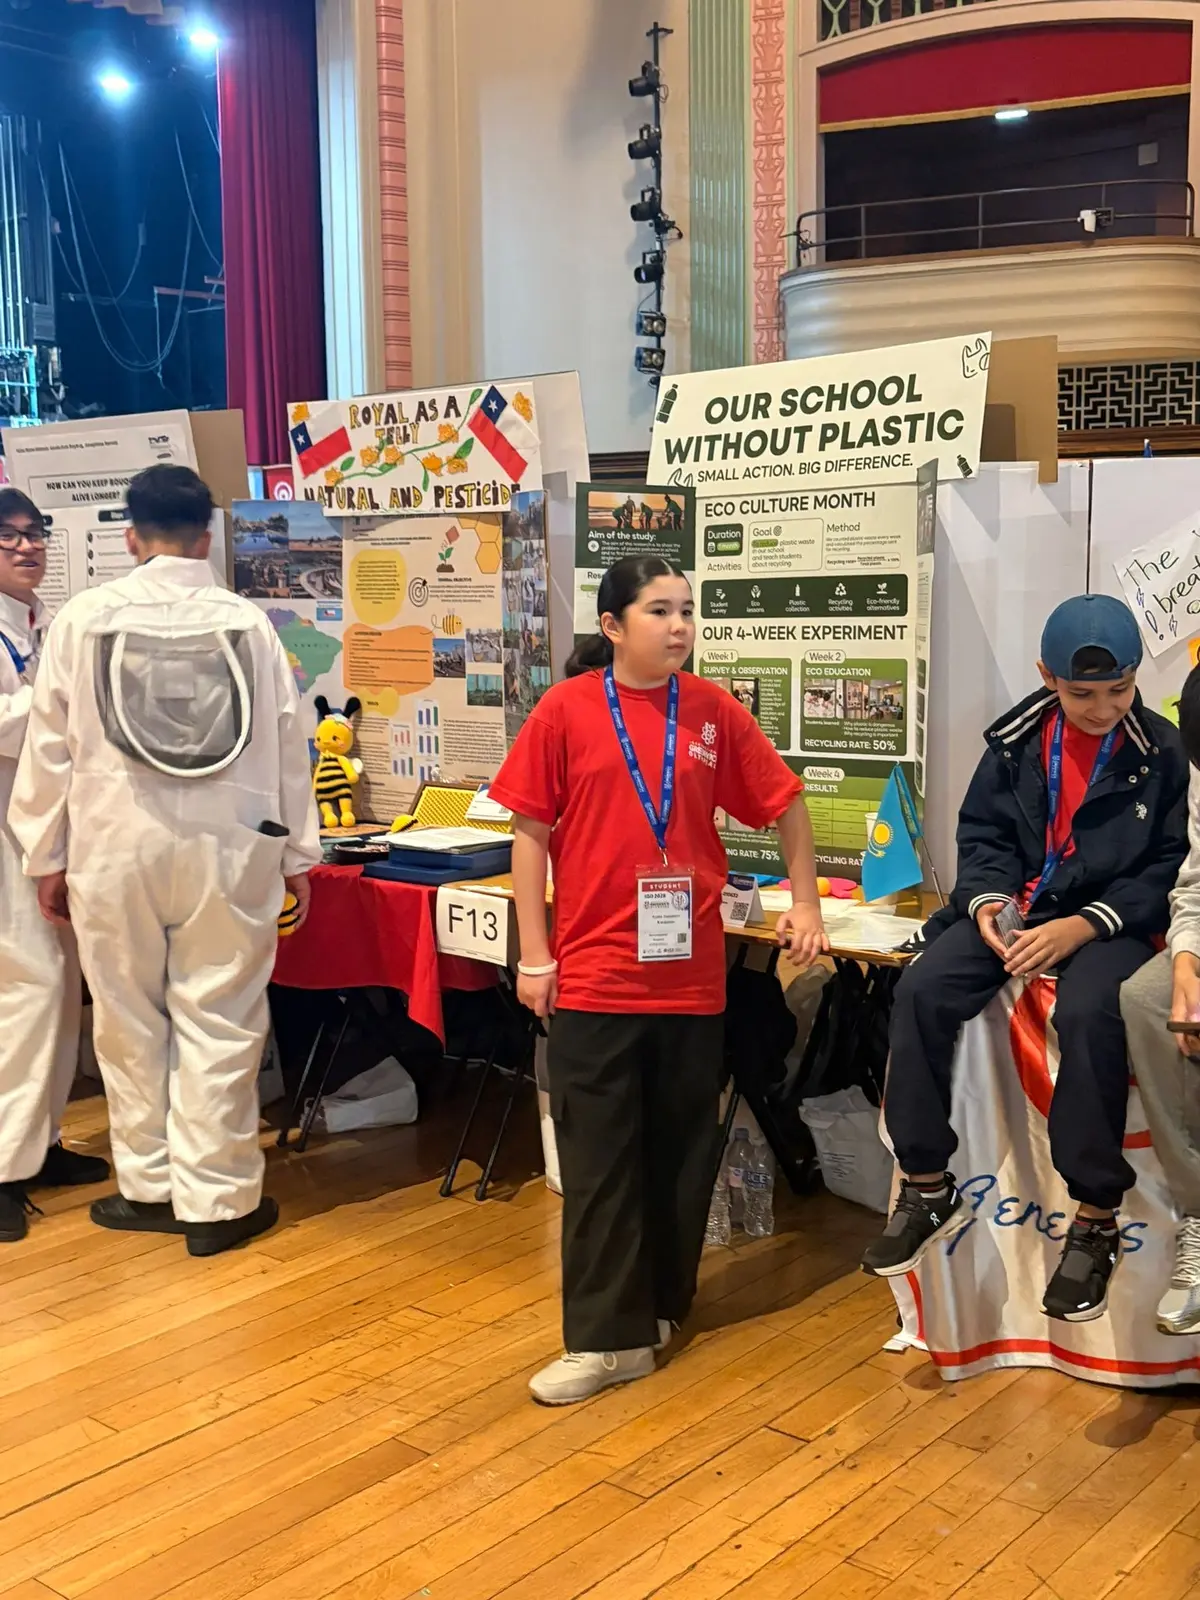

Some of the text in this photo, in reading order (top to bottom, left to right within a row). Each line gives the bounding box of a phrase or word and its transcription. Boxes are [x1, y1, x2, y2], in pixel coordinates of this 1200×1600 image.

[704, 374, 922, 424] OUR SCHOOL
[349, 396, 461, 429] ROYAL AS A
[664, 408, 964, 464] WITHOUT PLASTIC
[698, 454, 914, 483] SMALL ACTION. BIG DIFFERENCE.
[304, 486, 380, 510] NATURAL
[389, 486, 422, 508] AND
[705, 492, 876, 517] ECO CULTURE MONTH
[753, 527, 772, 537] Goal
[826, 522, 860, 532] Method
[588, 531, 657, 542] Aim of the study:
[708, 530, 741, 539] Duration
[707, 563, 742, 572] Activities
[1123, 550, 1180, 587] The
[703, 625, 908, 640] OUR 4-WEEK EXPERIMENT
[708, 652, 729, 660] Week
[809, 652, 834, 661] Week
[738, 667, 788, 675] OBSERVATION
[806, 668, 871, 676] ECO EDUCATION
[805, 739, 896, 750] RECYCLING RATE: 50%
[808, 769, 840, 778] Week 4
[805, 783, 838, 793] RESULTS
[740, 849, 759, 858] RATE:
[760, 850, 780, 860] 75%
[815, 855, 863, 866] CYCLING RAT
[448, 903, 498, 941] F13
